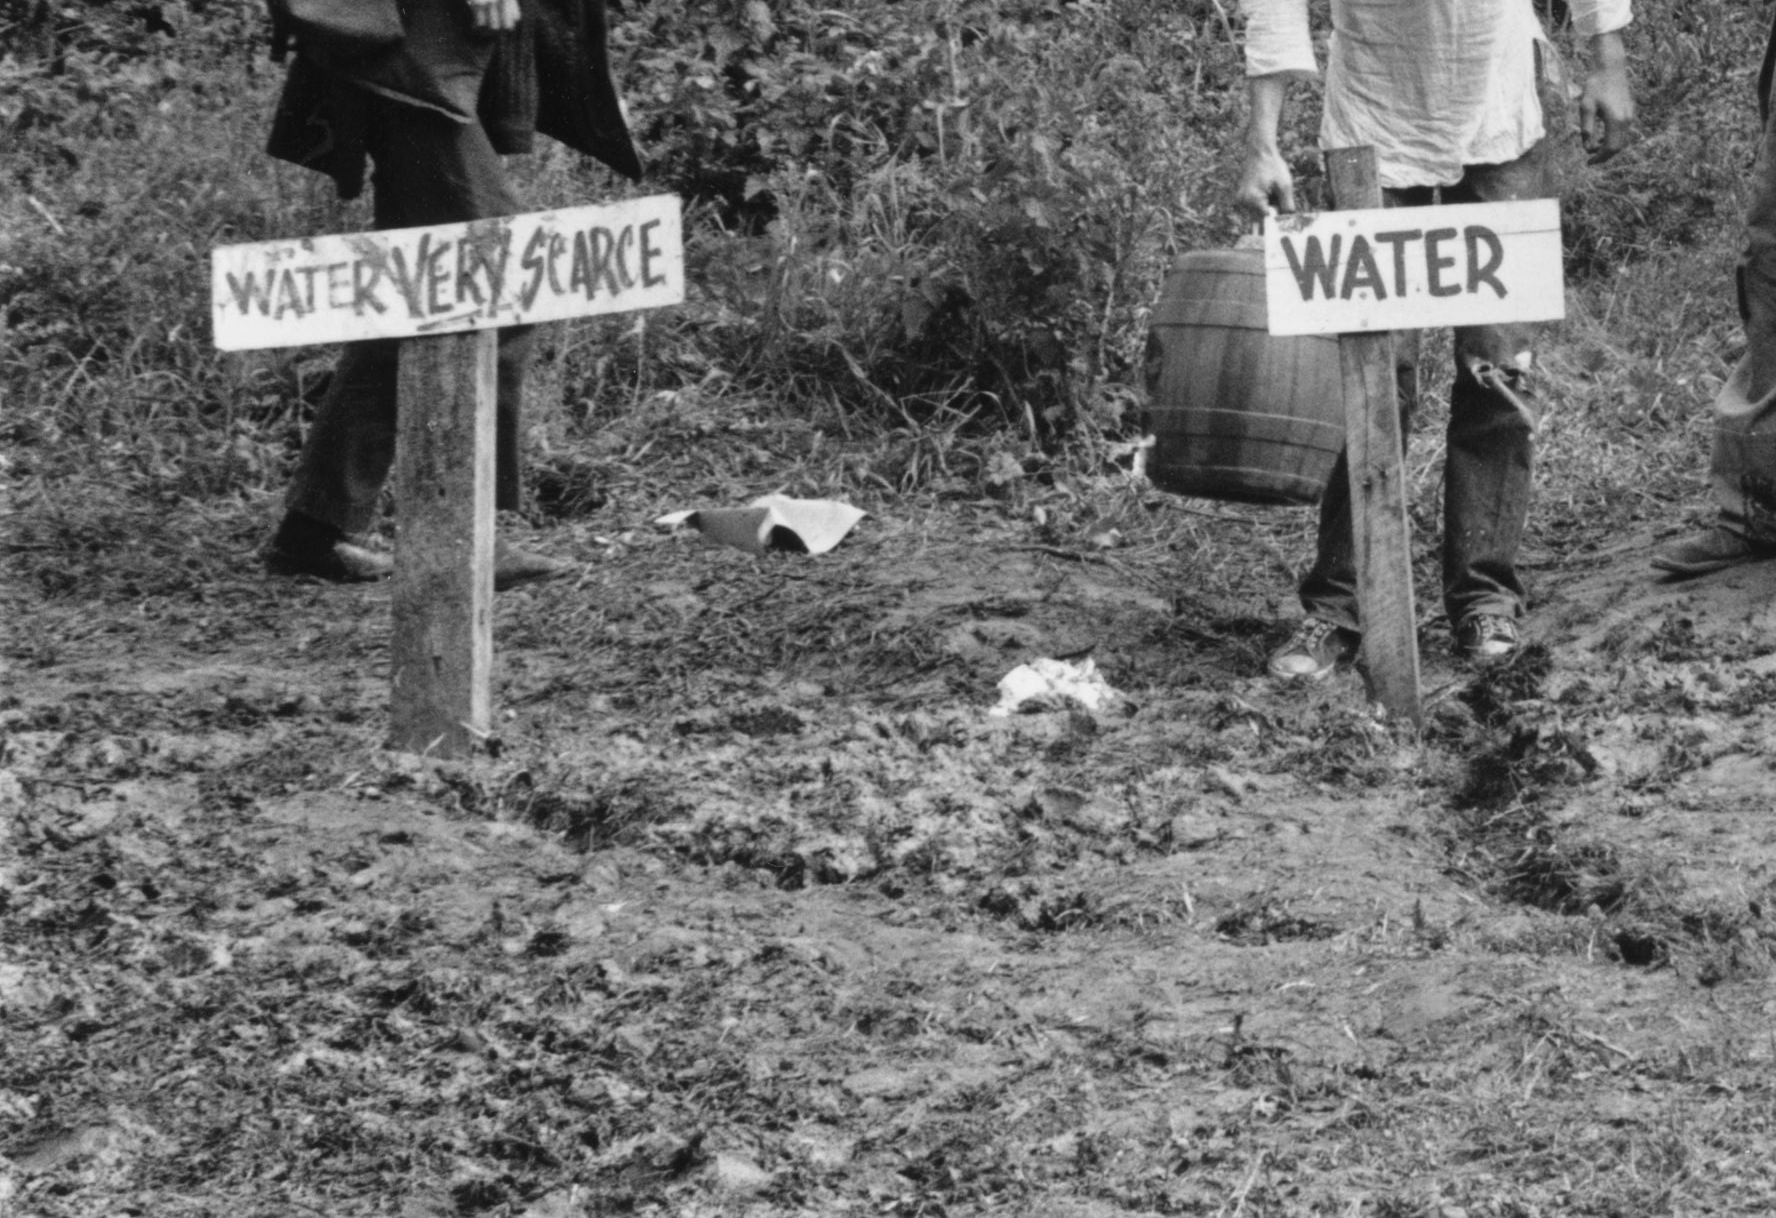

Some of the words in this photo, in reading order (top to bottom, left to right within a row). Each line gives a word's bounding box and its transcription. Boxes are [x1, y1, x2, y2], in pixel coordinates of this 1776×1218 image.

[226, 261, 388, 320] WATER
[390, 229, 513, 318] VERY
[521, 218, 667, 313] SCARCE
[1280, 225, 1508, 302] WATER
